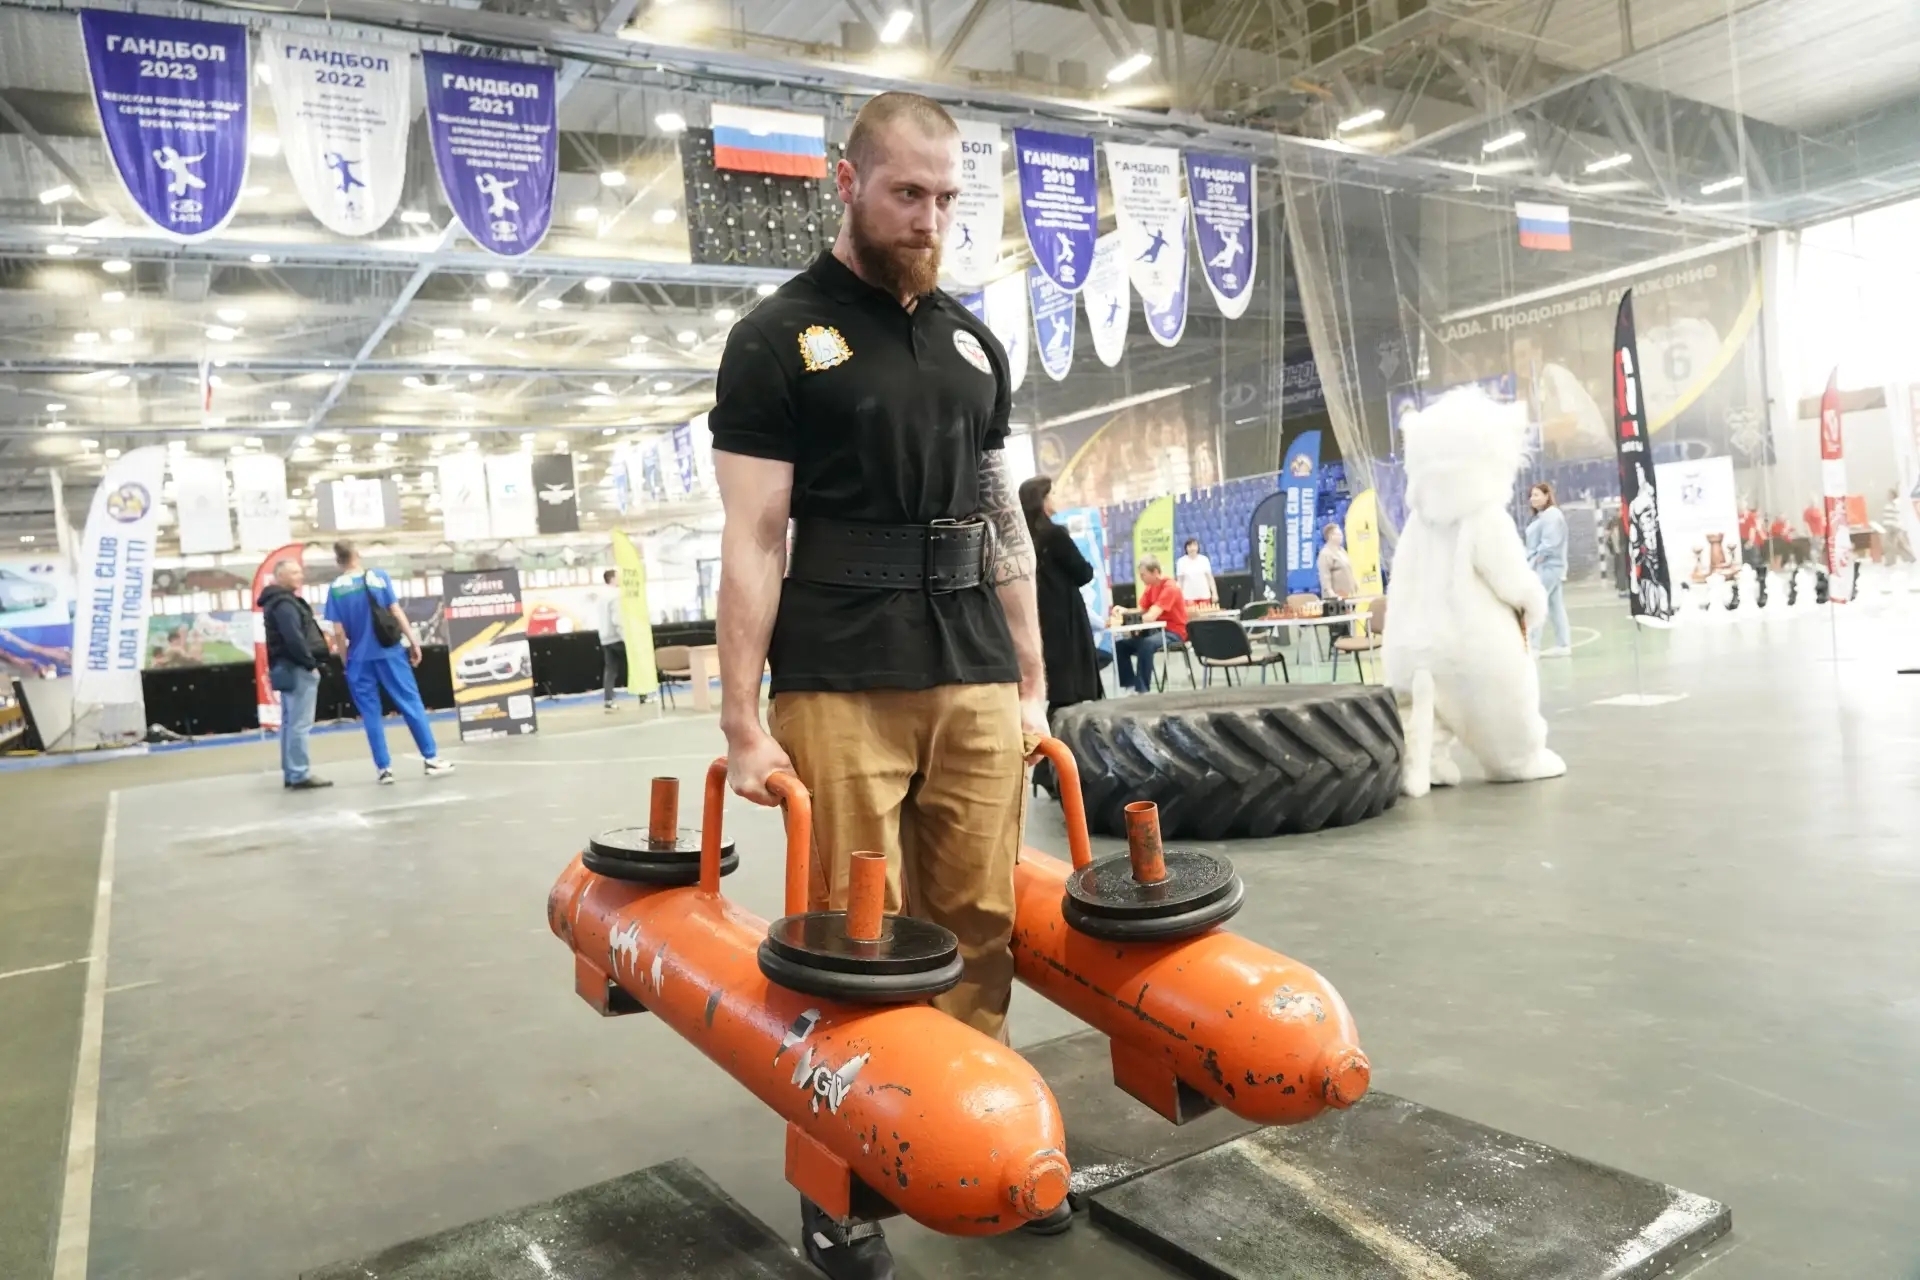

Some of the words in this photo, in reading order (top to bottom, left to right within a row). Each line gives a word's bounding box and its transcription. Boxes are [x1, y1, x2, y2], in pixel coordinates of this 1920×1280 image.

[106, 34, 226, 62] ГАНДБОЛ
[285, 45, 389, 72] ГАНДБОЛ
[140, 60, 198, 80] 2023
[315, 70, 366, 88] 2022
[442, 73, 539, 99] ГАНДБОЛ
[468, 96, 514, 116] 2021
[1023, 150, 1089, 171] ГАНДБОЛ
[1114, 160, 1170, 174] ГАНДБОЛ
[1042, 169, 1075, 186] 2019
[1193, 166, 1245, 183] ГАНДБОЛ
[1206, 183, 1235, 196] 2017
[1492, 289, 1603, 332] Продолжай
[94, 536, 118, 578] CLUB
[121, 540, 148, 622] TOGLIATTI
[88, 585, 114, 671] HANDBALL
[117, 628, 139, 670] LADA
